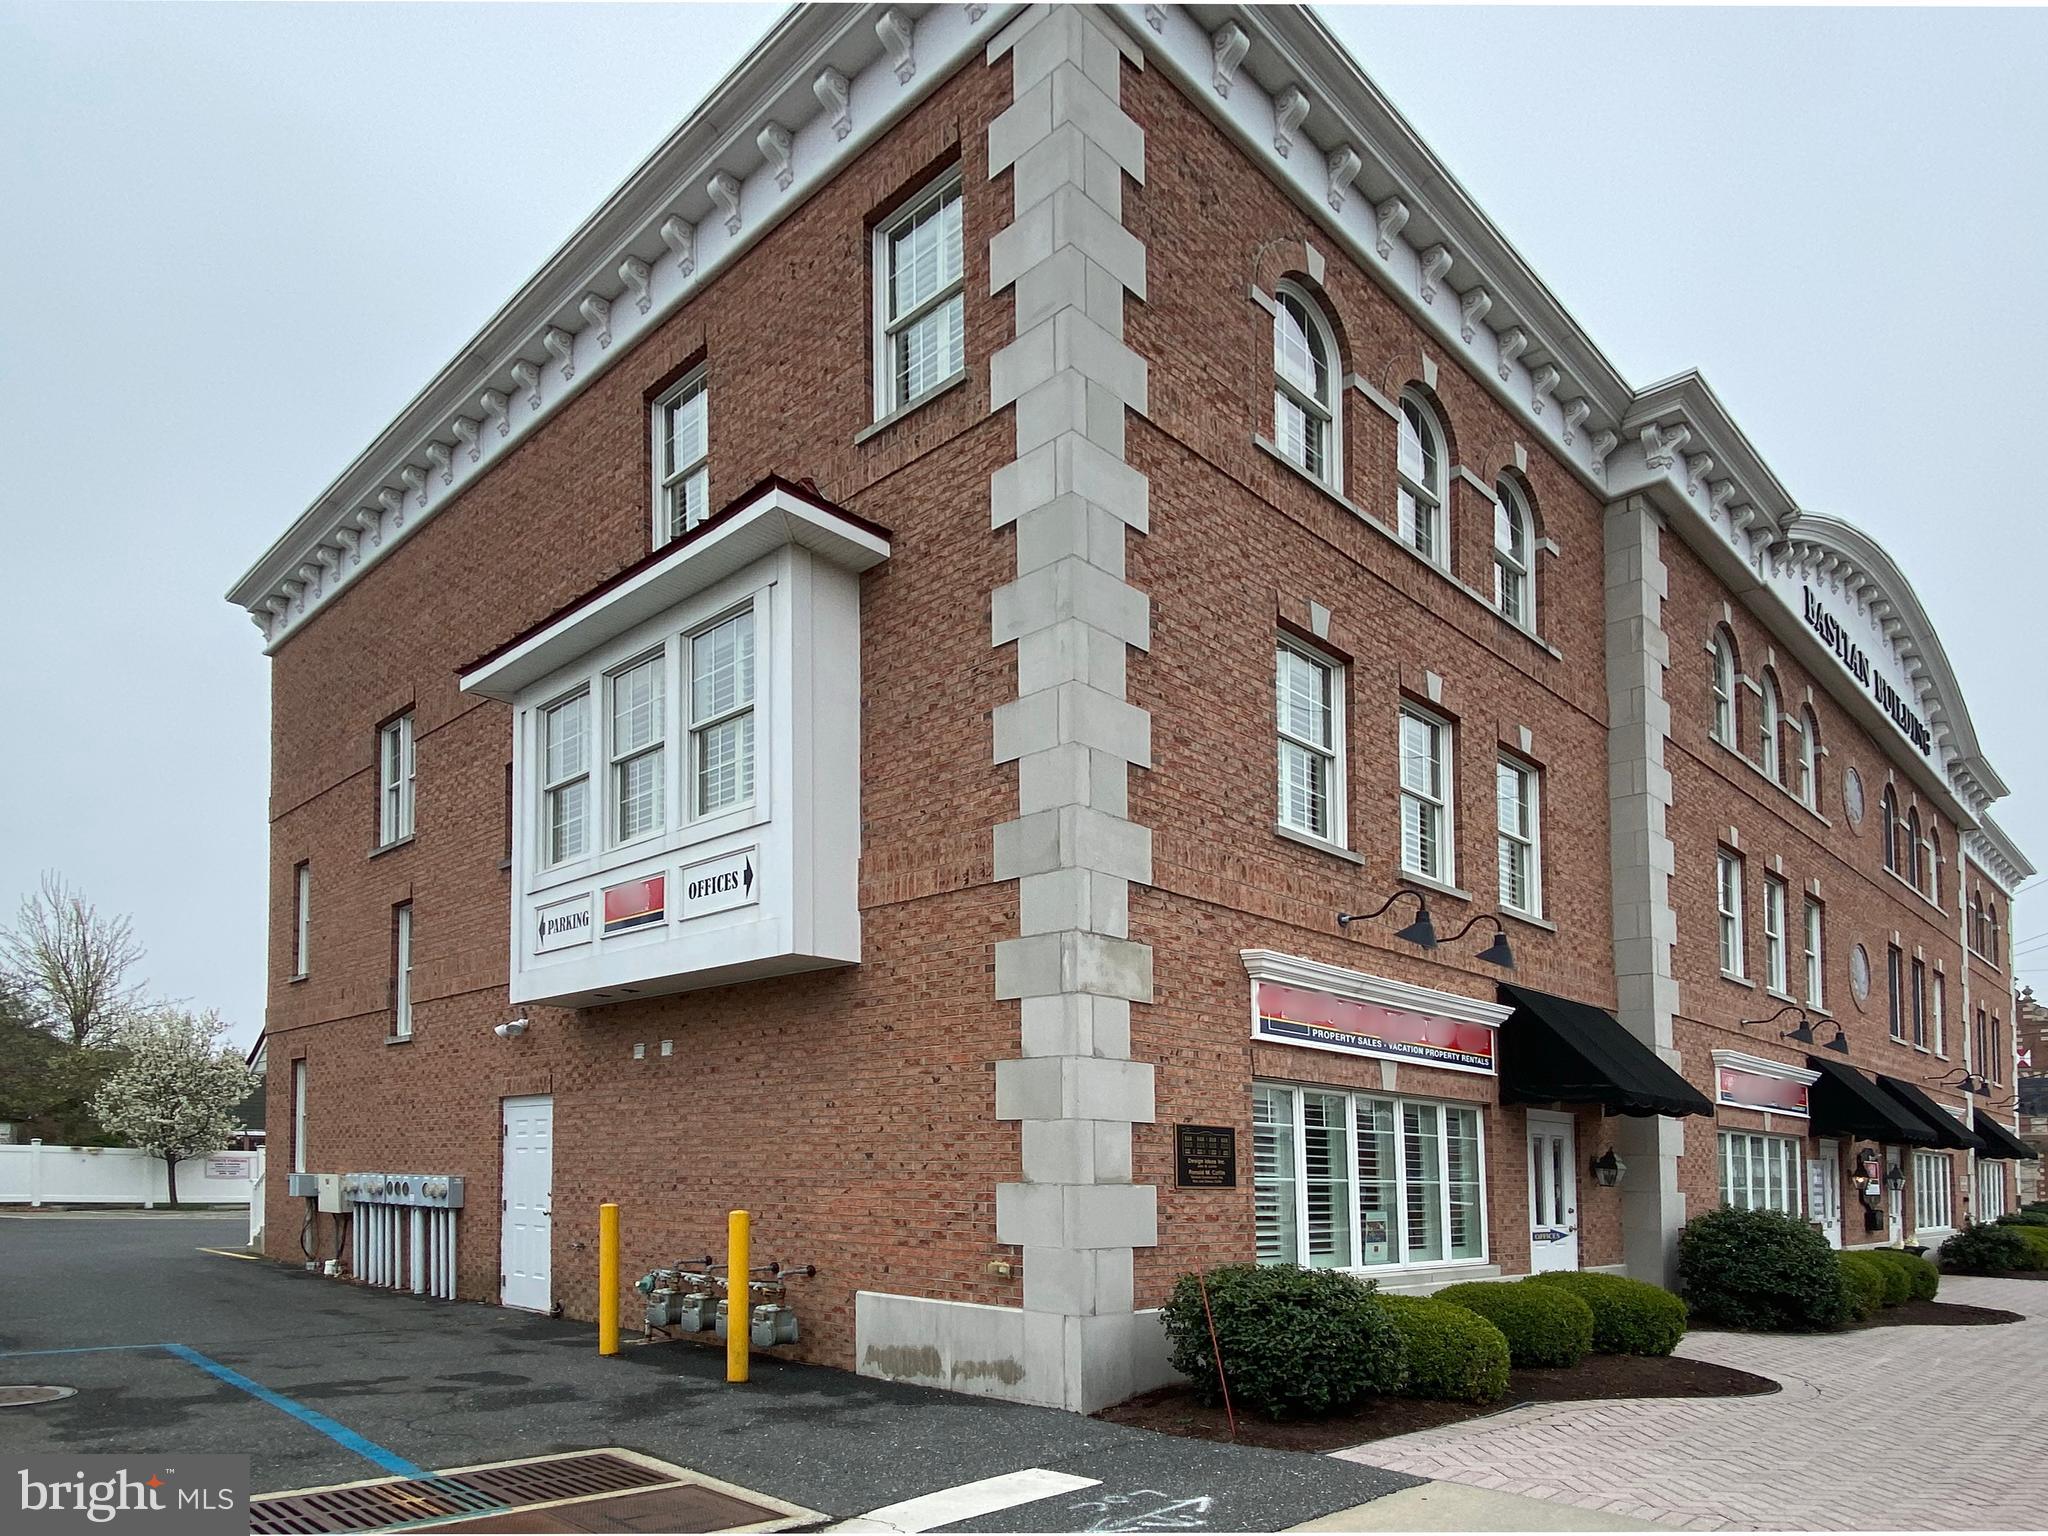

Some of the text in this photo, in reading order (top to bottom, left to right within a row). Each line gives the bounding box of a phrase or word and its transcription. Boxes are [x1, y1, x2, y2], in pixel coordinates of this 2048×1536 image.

[1873, 669, 1931, 756] BUILDING
[688, 870, 739, 900] OFFICES
[547, 910, 590, 936] PARKING
[1312, 1028, 1490, 1066] PROPERTY SALES VACATION PROPERTY RENTALS
